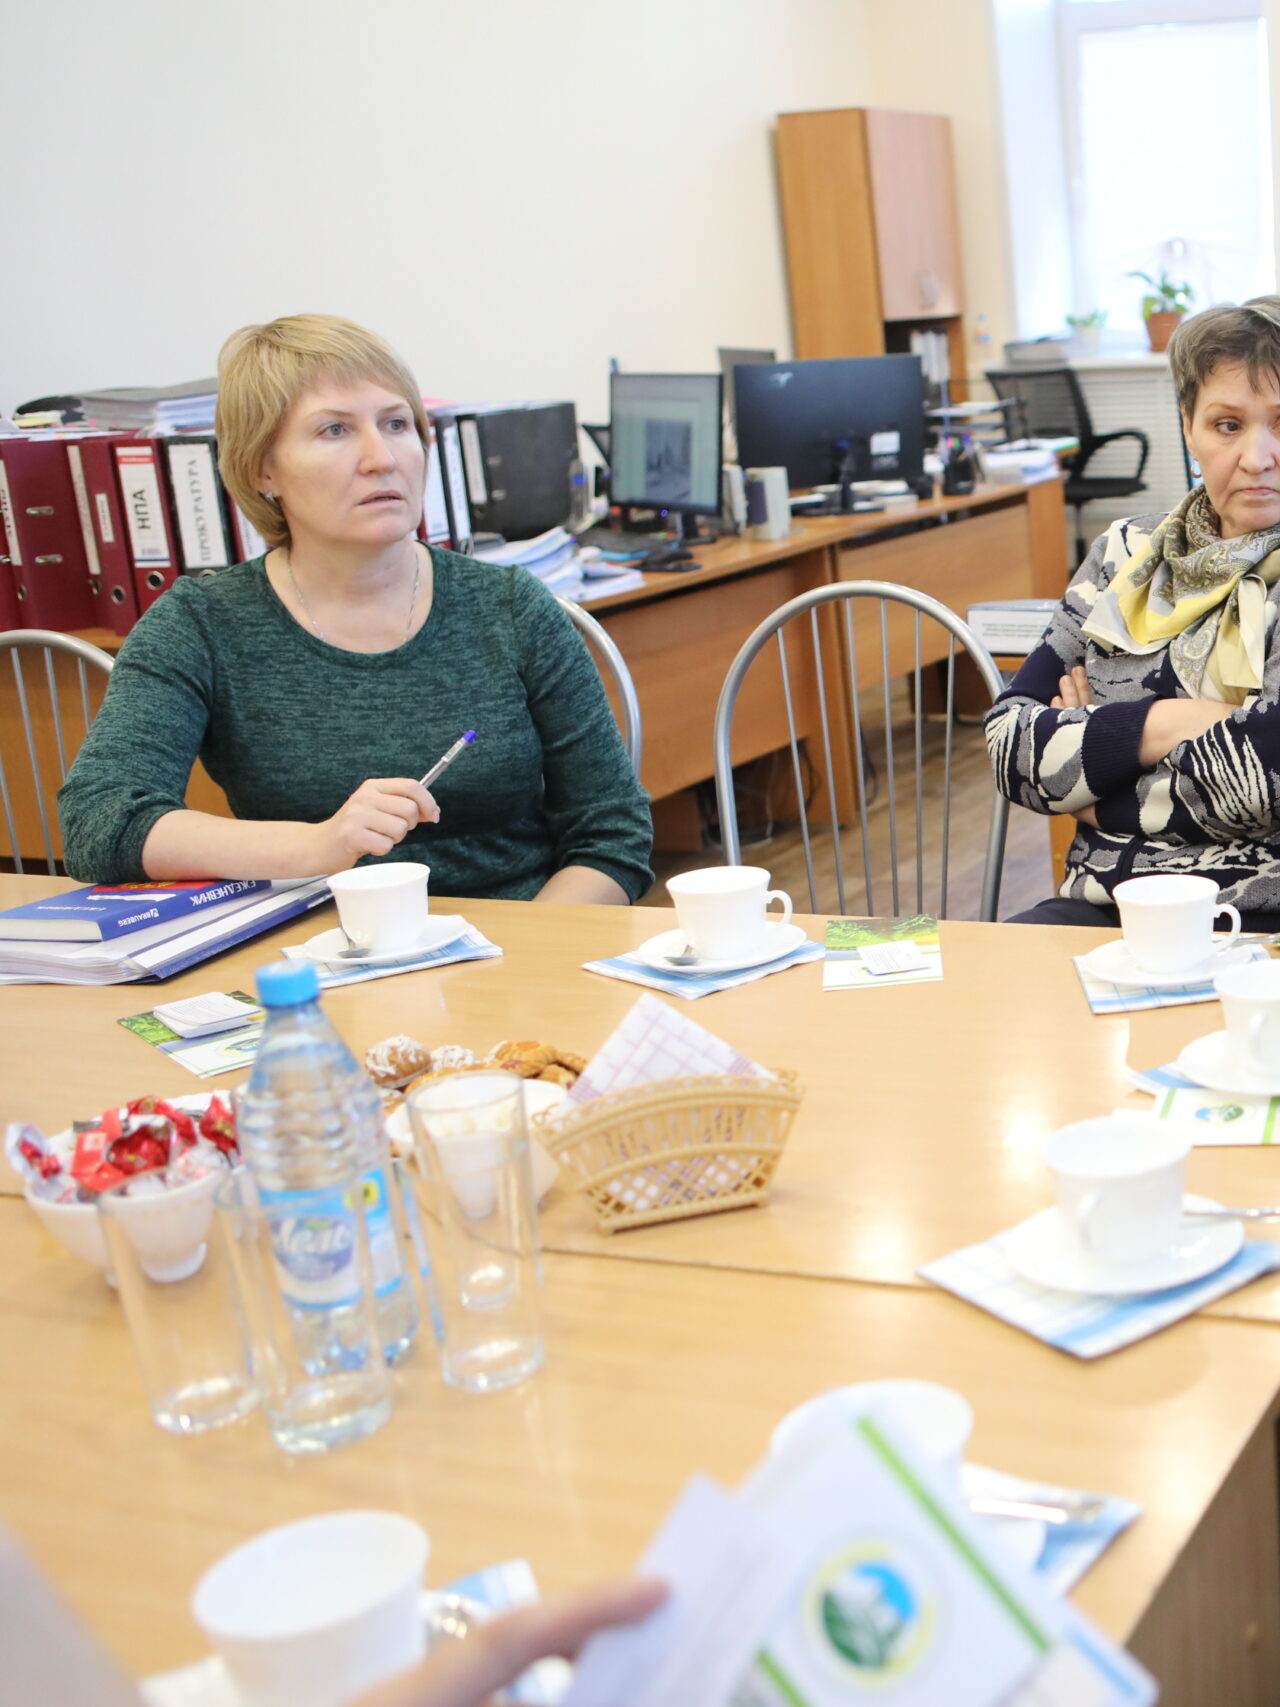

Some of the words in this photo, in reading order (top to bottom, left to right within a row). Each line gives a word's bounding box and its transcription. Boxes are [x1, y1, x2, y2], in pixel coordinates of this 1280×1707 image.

[133, 488, 151, 530] НПА
[187, 459, 212, 561] ПРОКУРАТУРА
[189, 879, 257, 907] ЕЖЕДНЕВНИК
[117, 909, 155, 928] BRAUBERG
